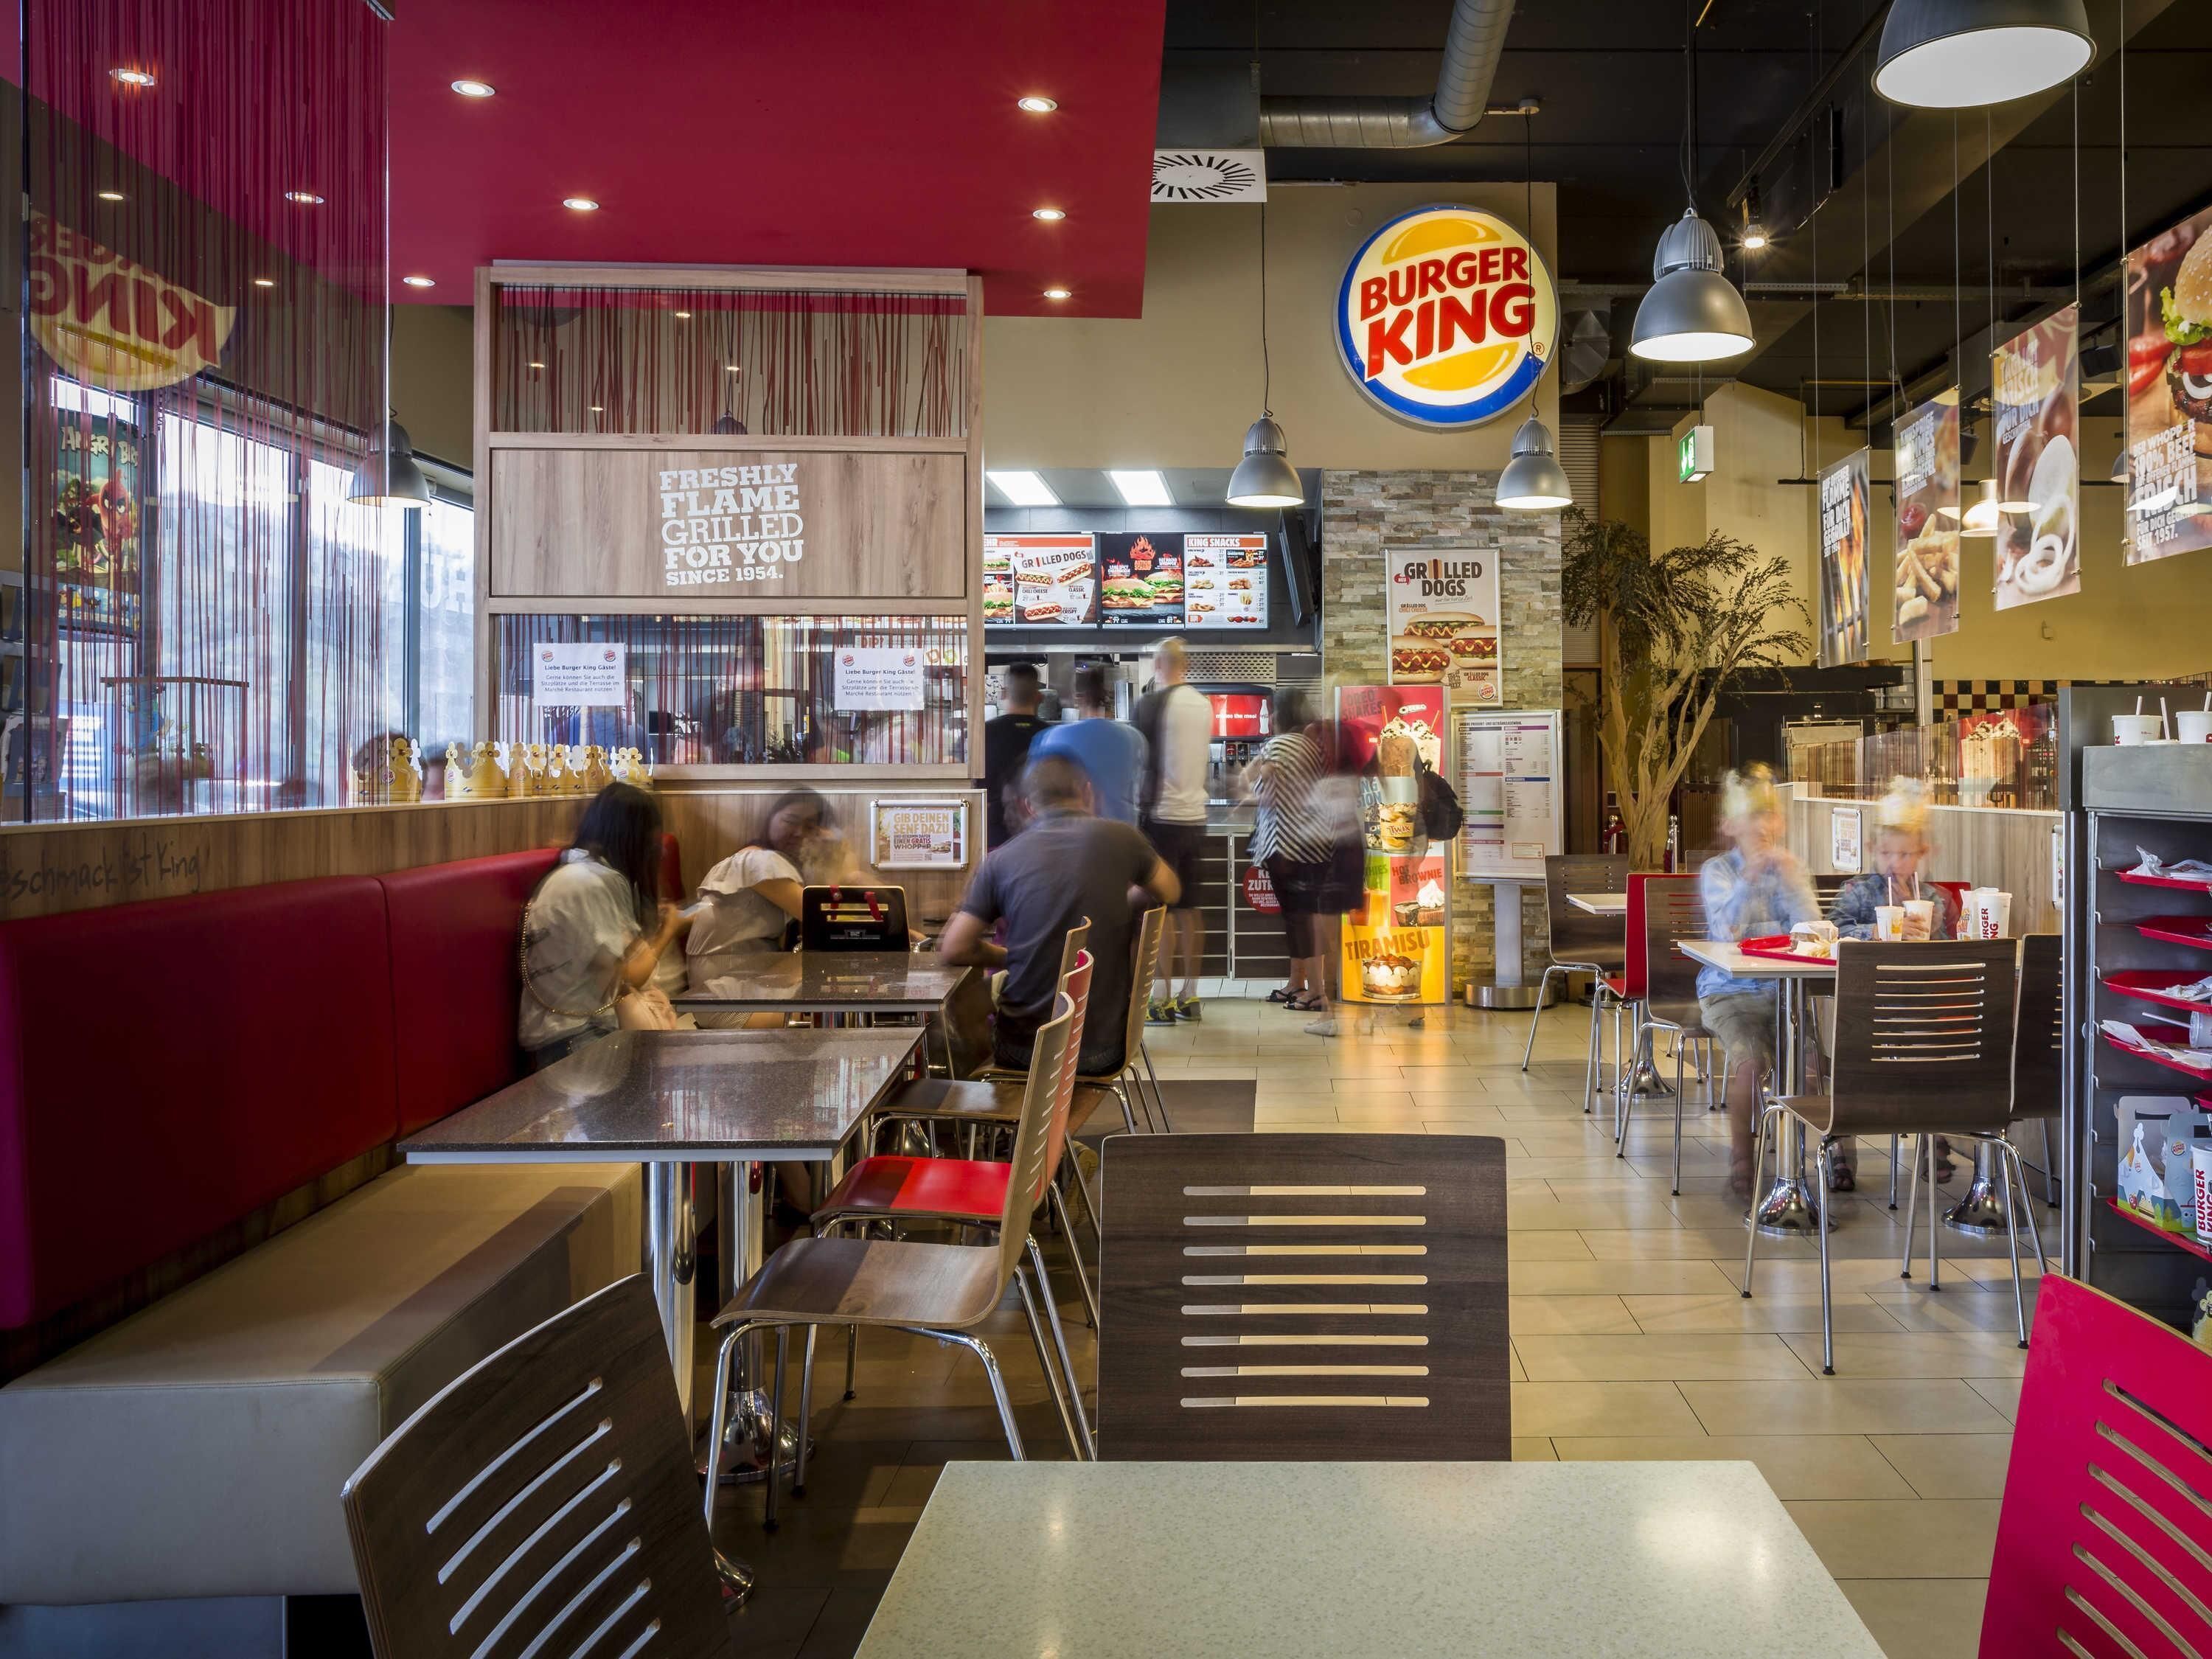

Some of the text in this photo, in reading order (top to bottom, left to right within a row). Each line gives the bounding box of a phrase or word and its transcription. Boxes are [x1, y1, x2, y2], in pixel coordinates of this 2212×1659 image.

[1360, 246, 1529, 321] BURGER
[1367, 282, 1536, 378] KING
[2167, 431, 2196, 465] BEEF
[659, 463, 797, 491] FRESHLY
[660, 484, 800, 518] FLAME
[661, 512, 804, 546] GRILLED
[664, 539, 804, 570] FOR YOU
[1189, 538, 1240, 547] KING SNACKS
[1063, 550, 1086, 561] DOGS
[666, 566, 784, 586] SINCE 1954.
[1404, 559, 1482, 580] GRILLED
[1422, 580, 1466, 597] DOGS
[894, 813, 949, 823] GIB DEINEN
[894, 824, 949, 834] SENF DAZU
[1391, 865, 1409, 877] HOT
[1398, 869, 1443, 885] BROWNIE
[1345, 930, 1430, 961] TIRAMISU
[2195, 1169, 2206, 1231] BURGER
